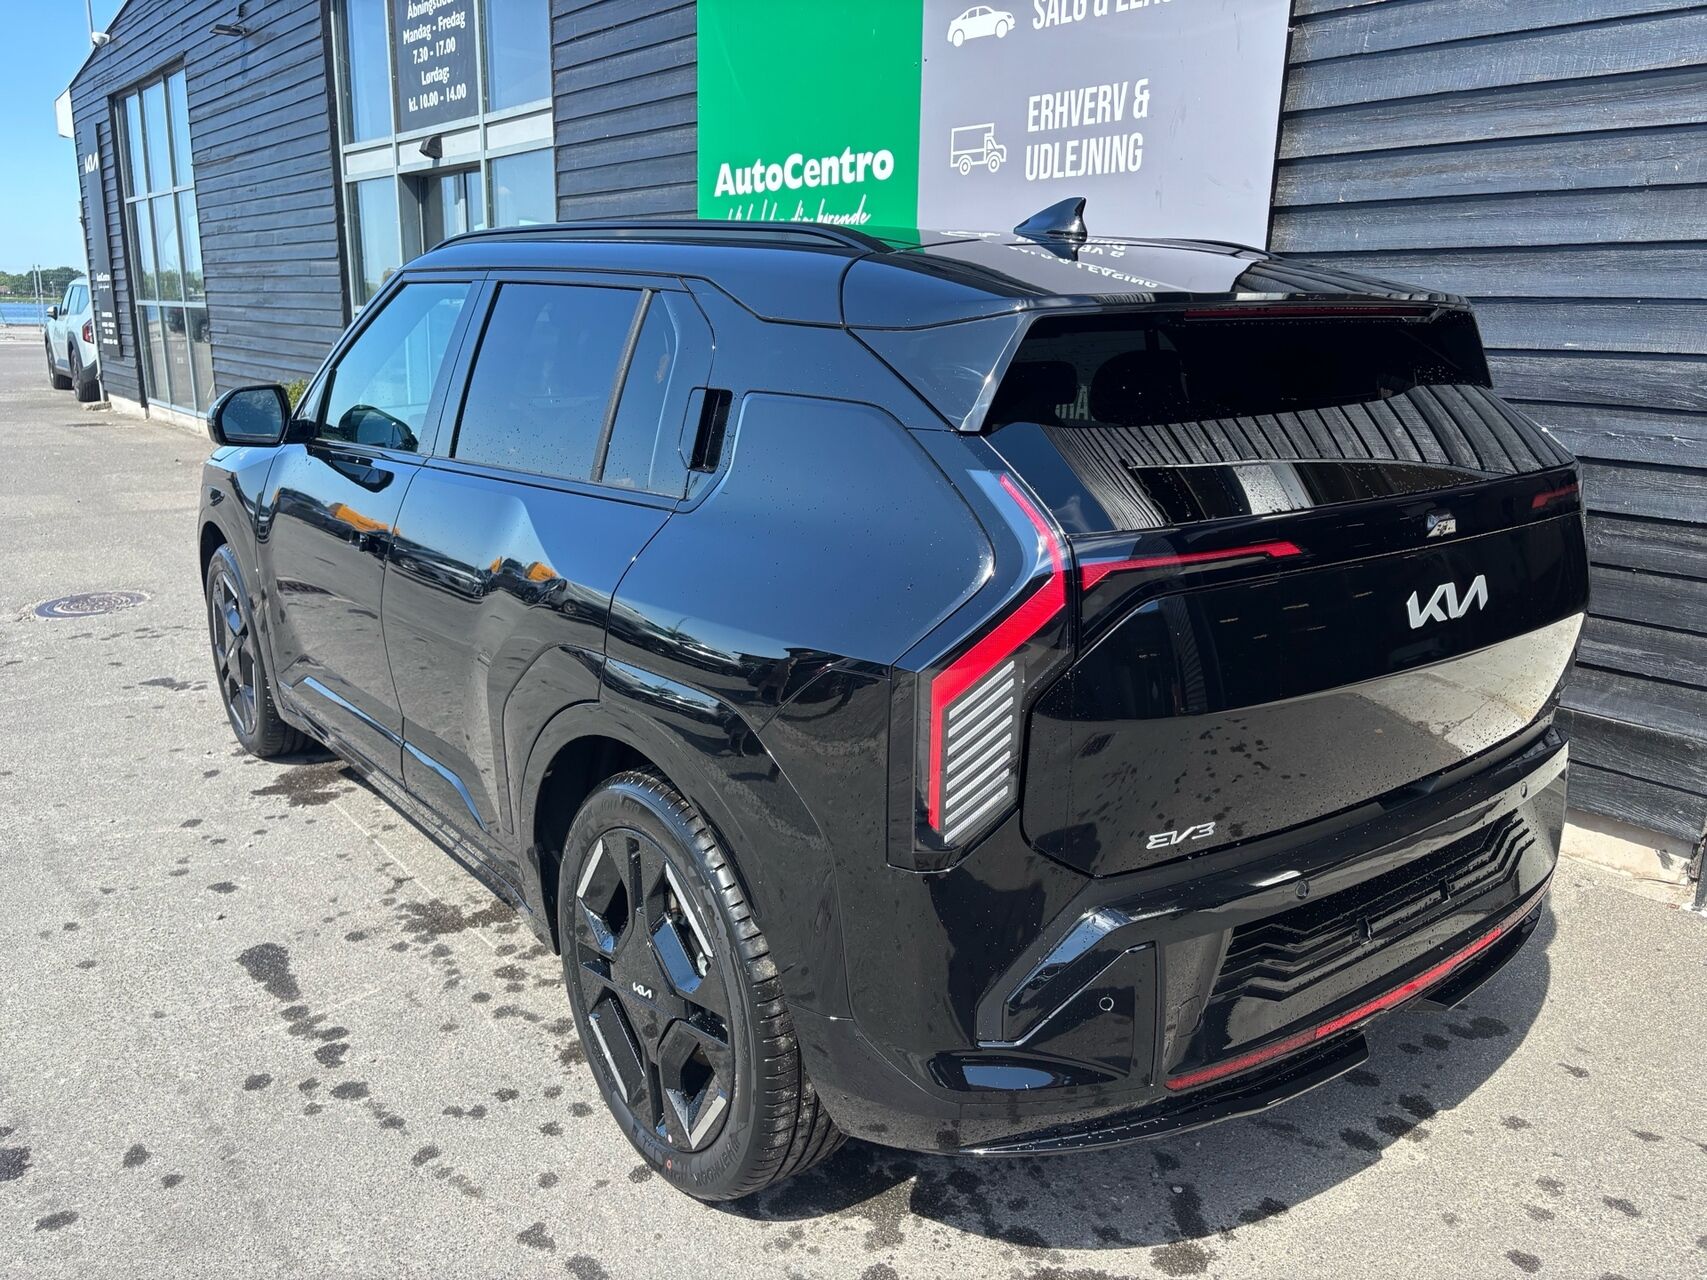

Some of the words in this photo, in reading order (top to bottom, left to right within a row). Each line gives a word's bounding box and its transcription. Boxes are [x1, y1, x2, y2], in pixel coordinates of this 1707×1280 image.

[402, 23, 432, 45] Mandag
[437, 10, 466, 32] Fredag
[412, 46, 429, 65] 7.30
[435, 36, 456, 58] 17.00
[421, 66, 450, 86] Lørdag:
[408, 97, 419, 113] kl.
[419, 90, 439, 110] 10.00
[446, 82, 467, 106] 14.00
[1027, 81, 1129, 133] ERHVERV
[1132, 78, 1151, 119] &
[713, 146, 895, 197] AutoCentro
[1025, 132, 1144, 181] UDLEJNING
[1406, 574, 1489, 630] KIA
[1145, 821, 1216, 850] EV3
[632, 981, 653, 999] KIA
